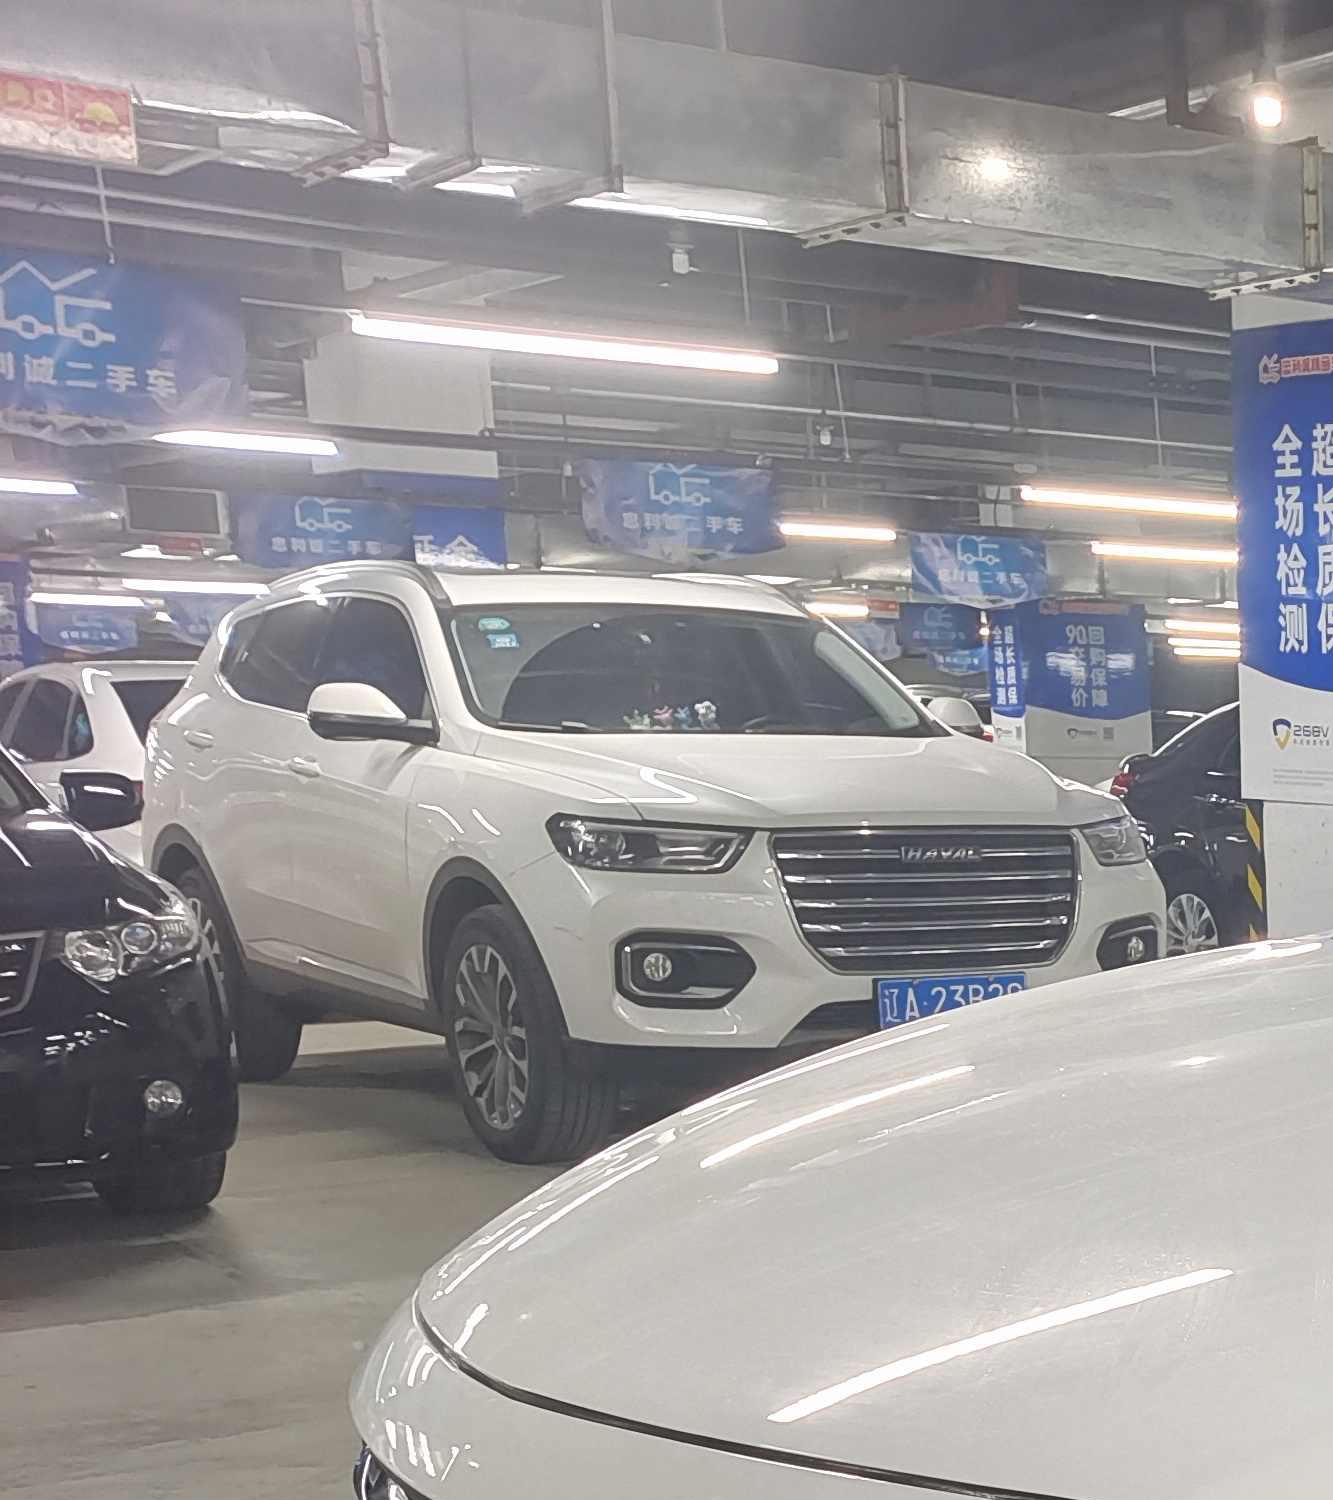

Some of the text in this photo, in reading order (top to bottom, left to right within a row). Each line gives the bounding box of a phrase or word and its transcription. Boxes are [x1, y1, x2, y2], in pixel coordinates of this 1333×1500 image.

[1272, 424, 1308, 654] 全场检测
[907, 846, 980, 860] HAVAL
